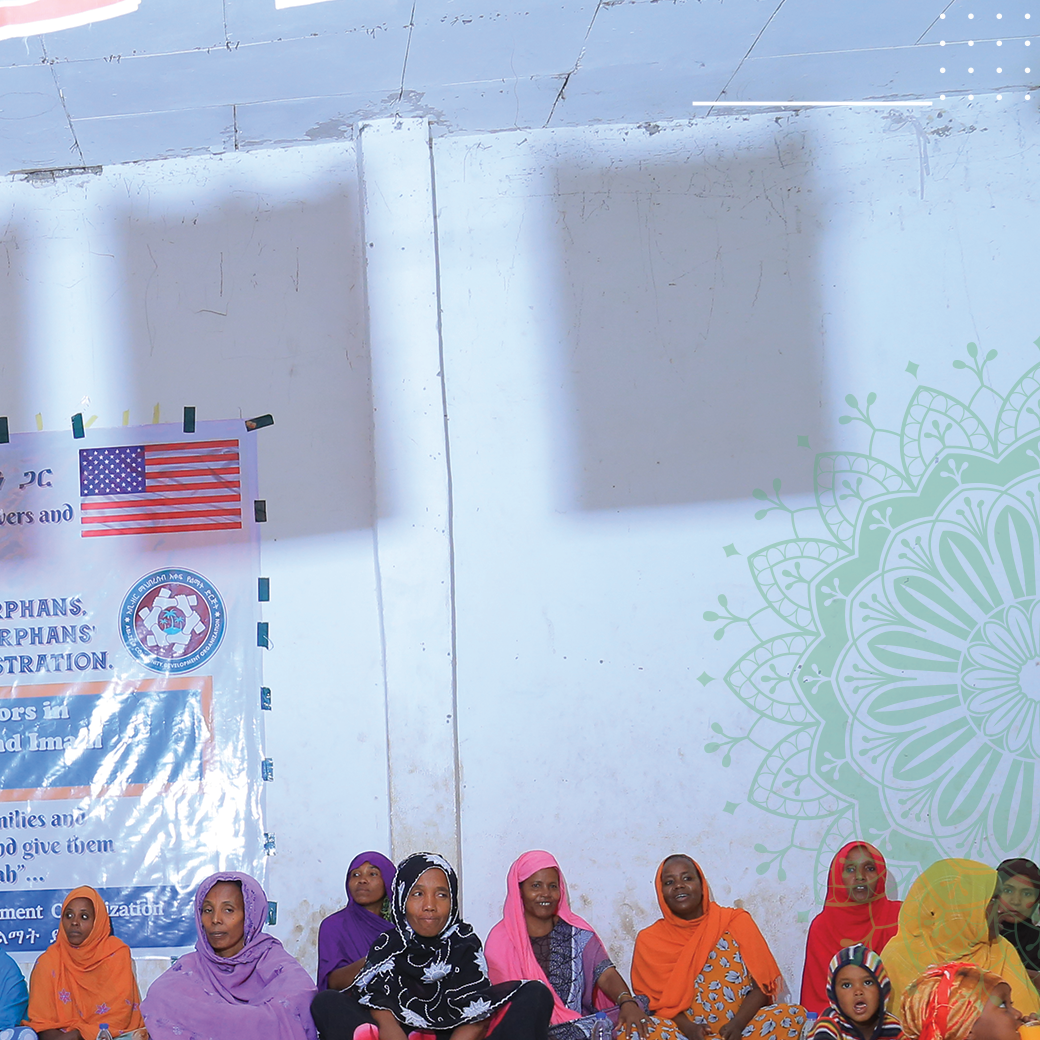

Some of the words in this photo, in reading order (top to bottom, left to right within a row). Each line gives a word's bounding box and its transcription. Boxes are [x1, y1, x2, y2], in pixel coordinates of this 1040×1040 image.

[19, 468, 53, 489] ጋር
[39, 503, 74, 524] and
[43, 700, 70, 719] in
[22, 838, 60, 861] give
[66, 835, 114, 855] them
